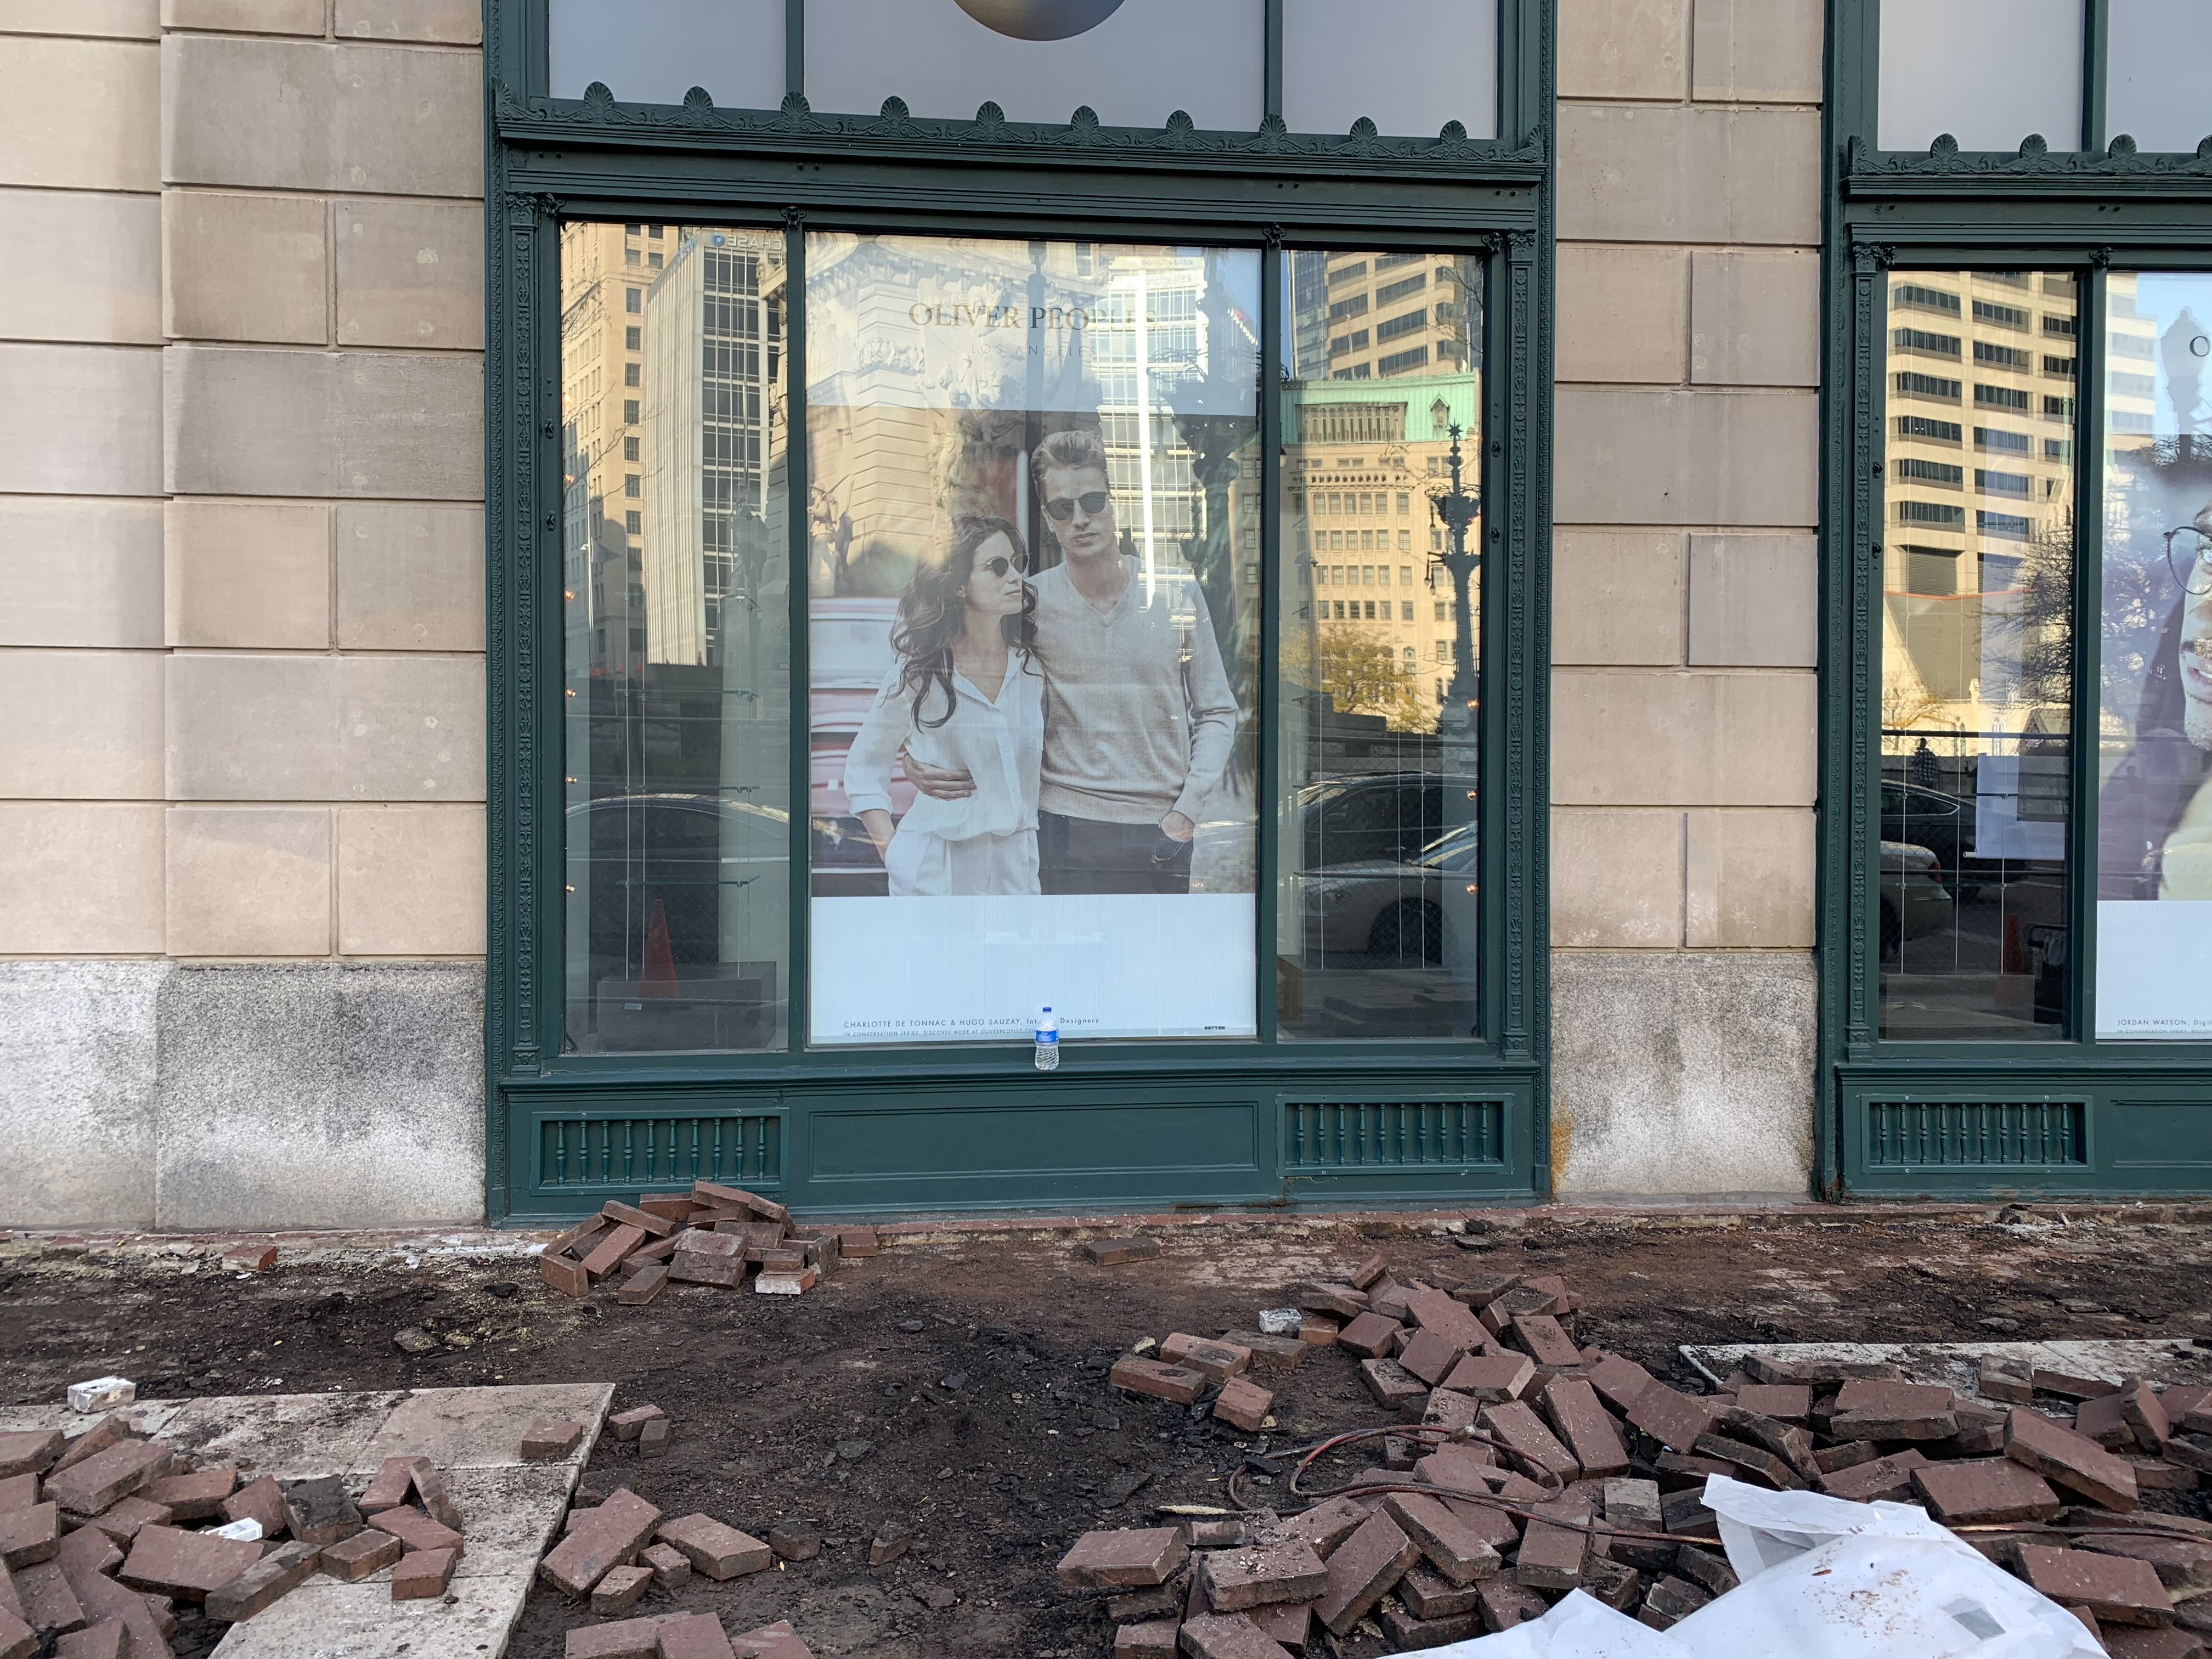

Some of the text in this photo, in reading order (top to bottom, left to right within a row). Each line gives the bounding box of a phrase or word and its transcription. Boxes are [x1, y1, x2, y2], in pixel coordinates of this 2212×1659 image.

[909, 303, 1156, 331] OLIVER PEOPLES
[972, 343, 1096, 357] LOS ANGELES
[2190, 336, 2211, 357] O
